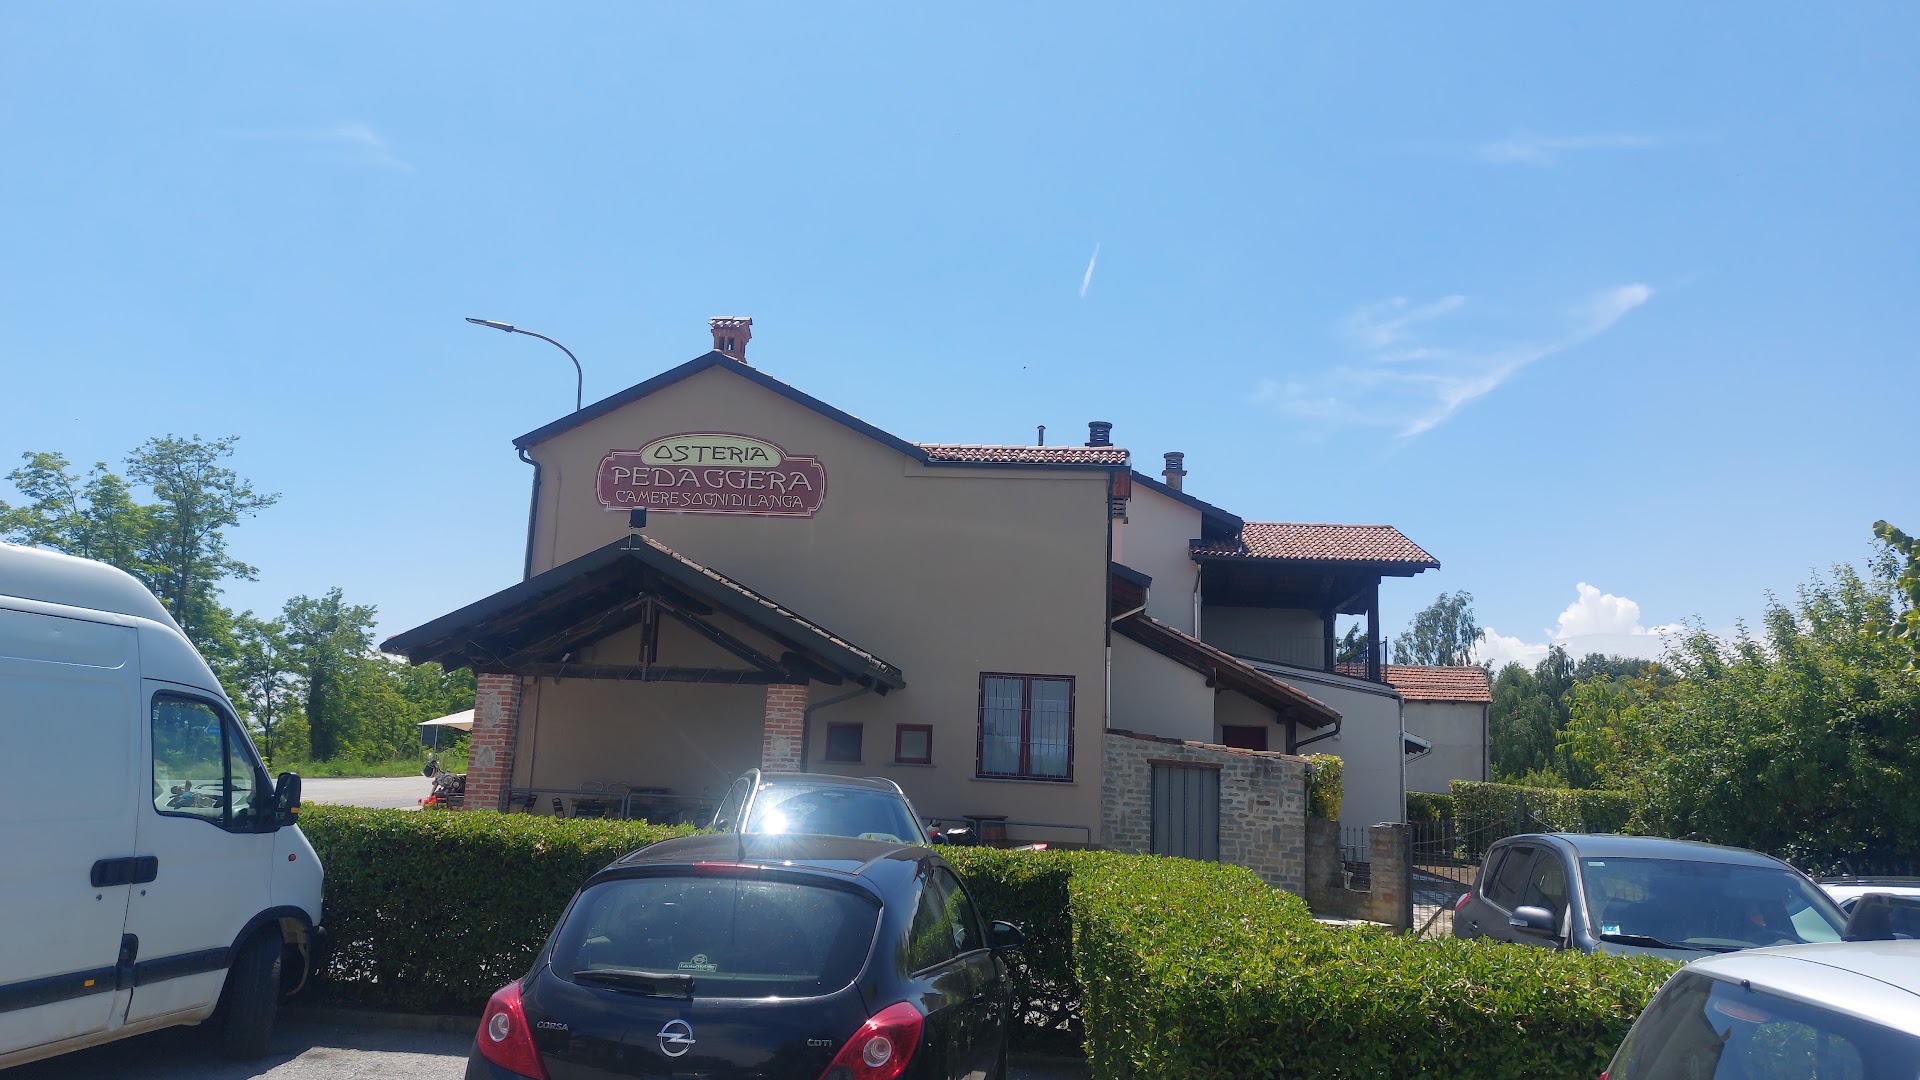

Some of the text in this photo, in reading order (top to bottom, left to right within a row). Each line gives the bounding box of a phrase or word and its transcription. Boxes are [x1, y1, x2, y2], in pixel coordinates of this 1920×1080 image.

[654, 446, 769, 463] OSTERIA
[611, 467, 812, 494] PEDAGGERA
[616, 490, 804, 509] CAMERE SOGNI DI LANGA
[537, 1021, 569, 1031] CORSA
